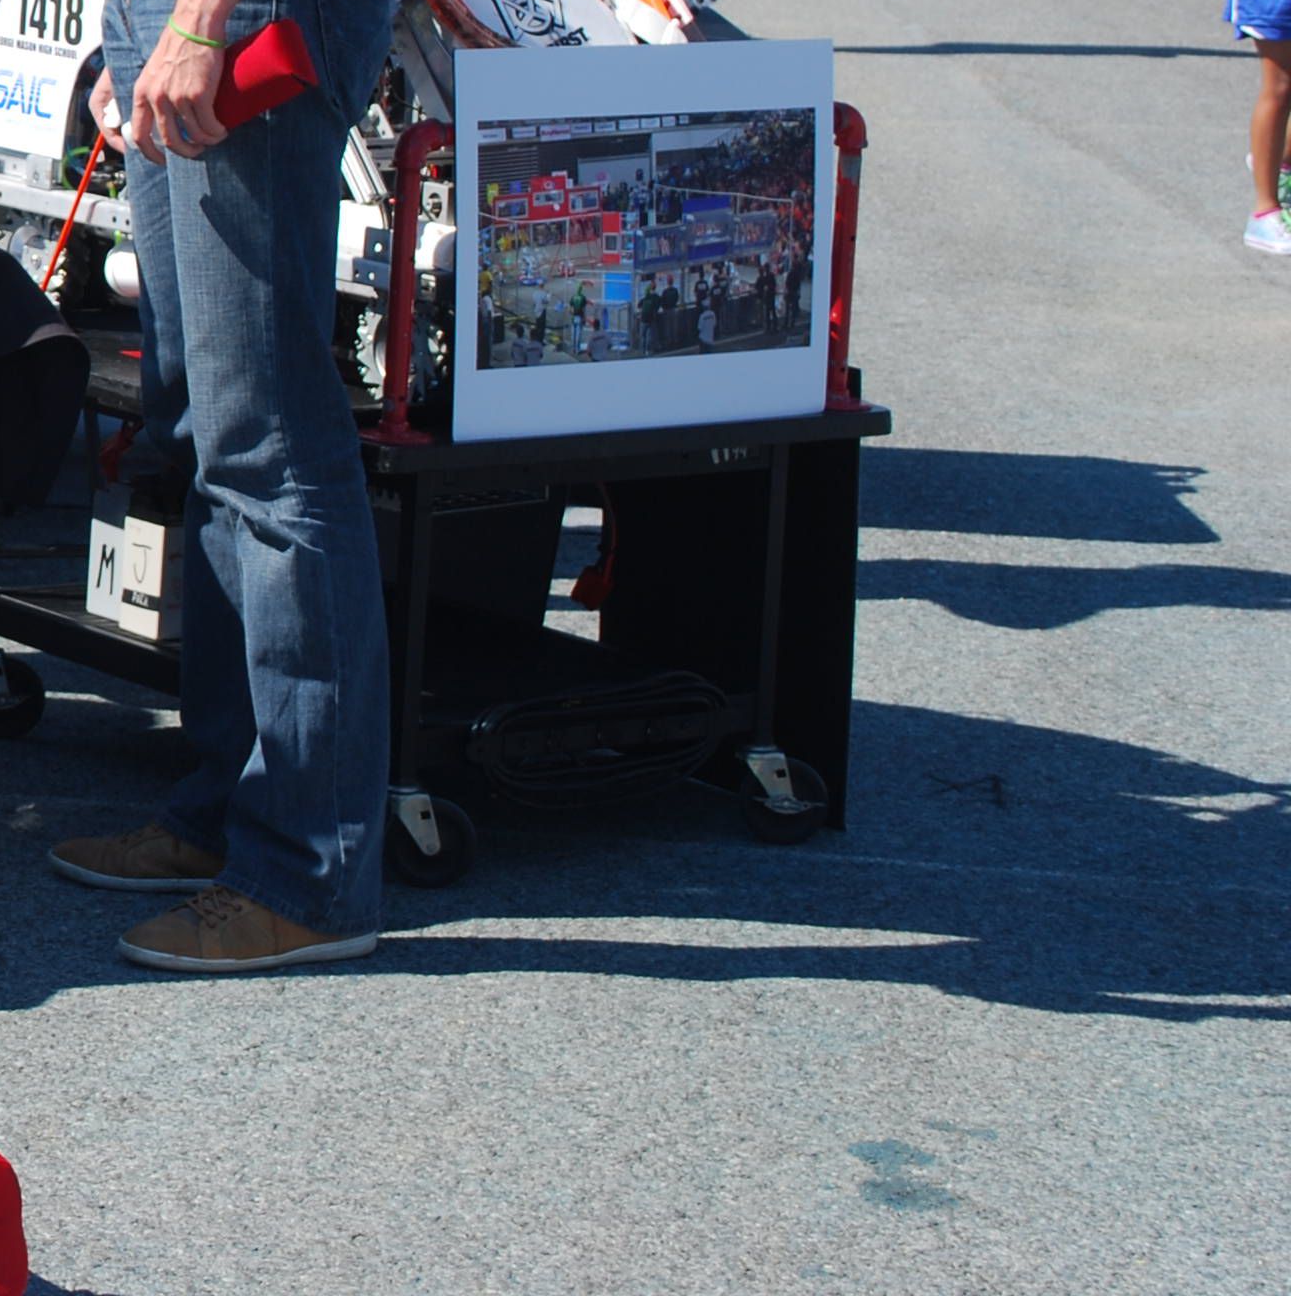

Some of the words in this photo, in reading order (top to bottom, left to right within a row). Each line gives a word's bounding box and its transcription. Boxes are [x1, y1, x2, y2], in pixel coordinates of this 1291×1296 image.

[16, 39, 37, 52] MASON
[38, 44, 53, 55] HIGH
[54, 46, 78, 60] SCHOOL
[96, 543, 116, 596] M
[130, 542, 153, 584] J
